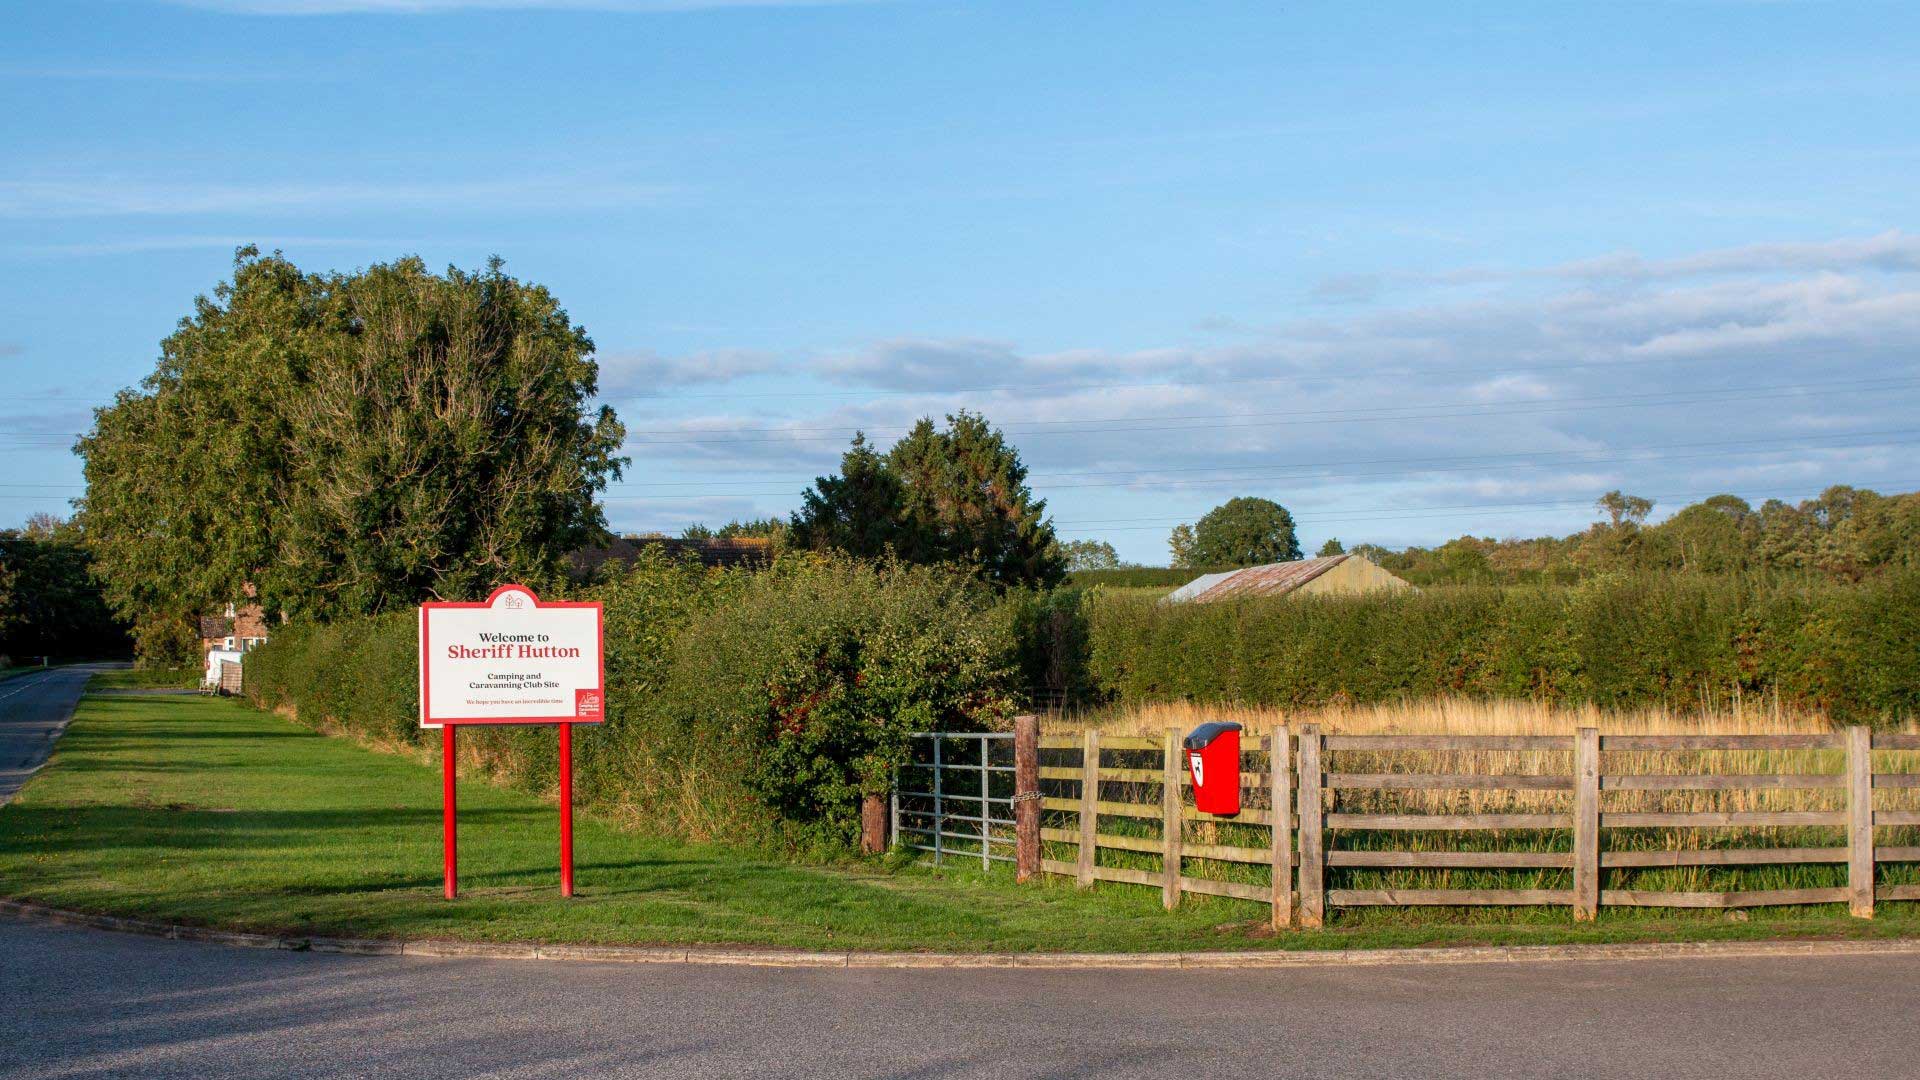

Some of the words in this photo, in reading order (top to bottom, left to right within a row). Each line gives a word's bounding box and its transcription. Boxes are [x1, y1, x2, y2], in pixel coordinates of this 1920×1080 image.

[479, 633, 535, 643] Welcome
[537, 633, 549, 643] to
[448, 644, 514, 659] Sheriff
[518, 645, 580, 658] Hutton
[487, 673, 525, 682] Camping
[469, 681, 522, 690] Caravanning
[523, 681, 542, 689] Club
[544, 680, 560, 688] Site
